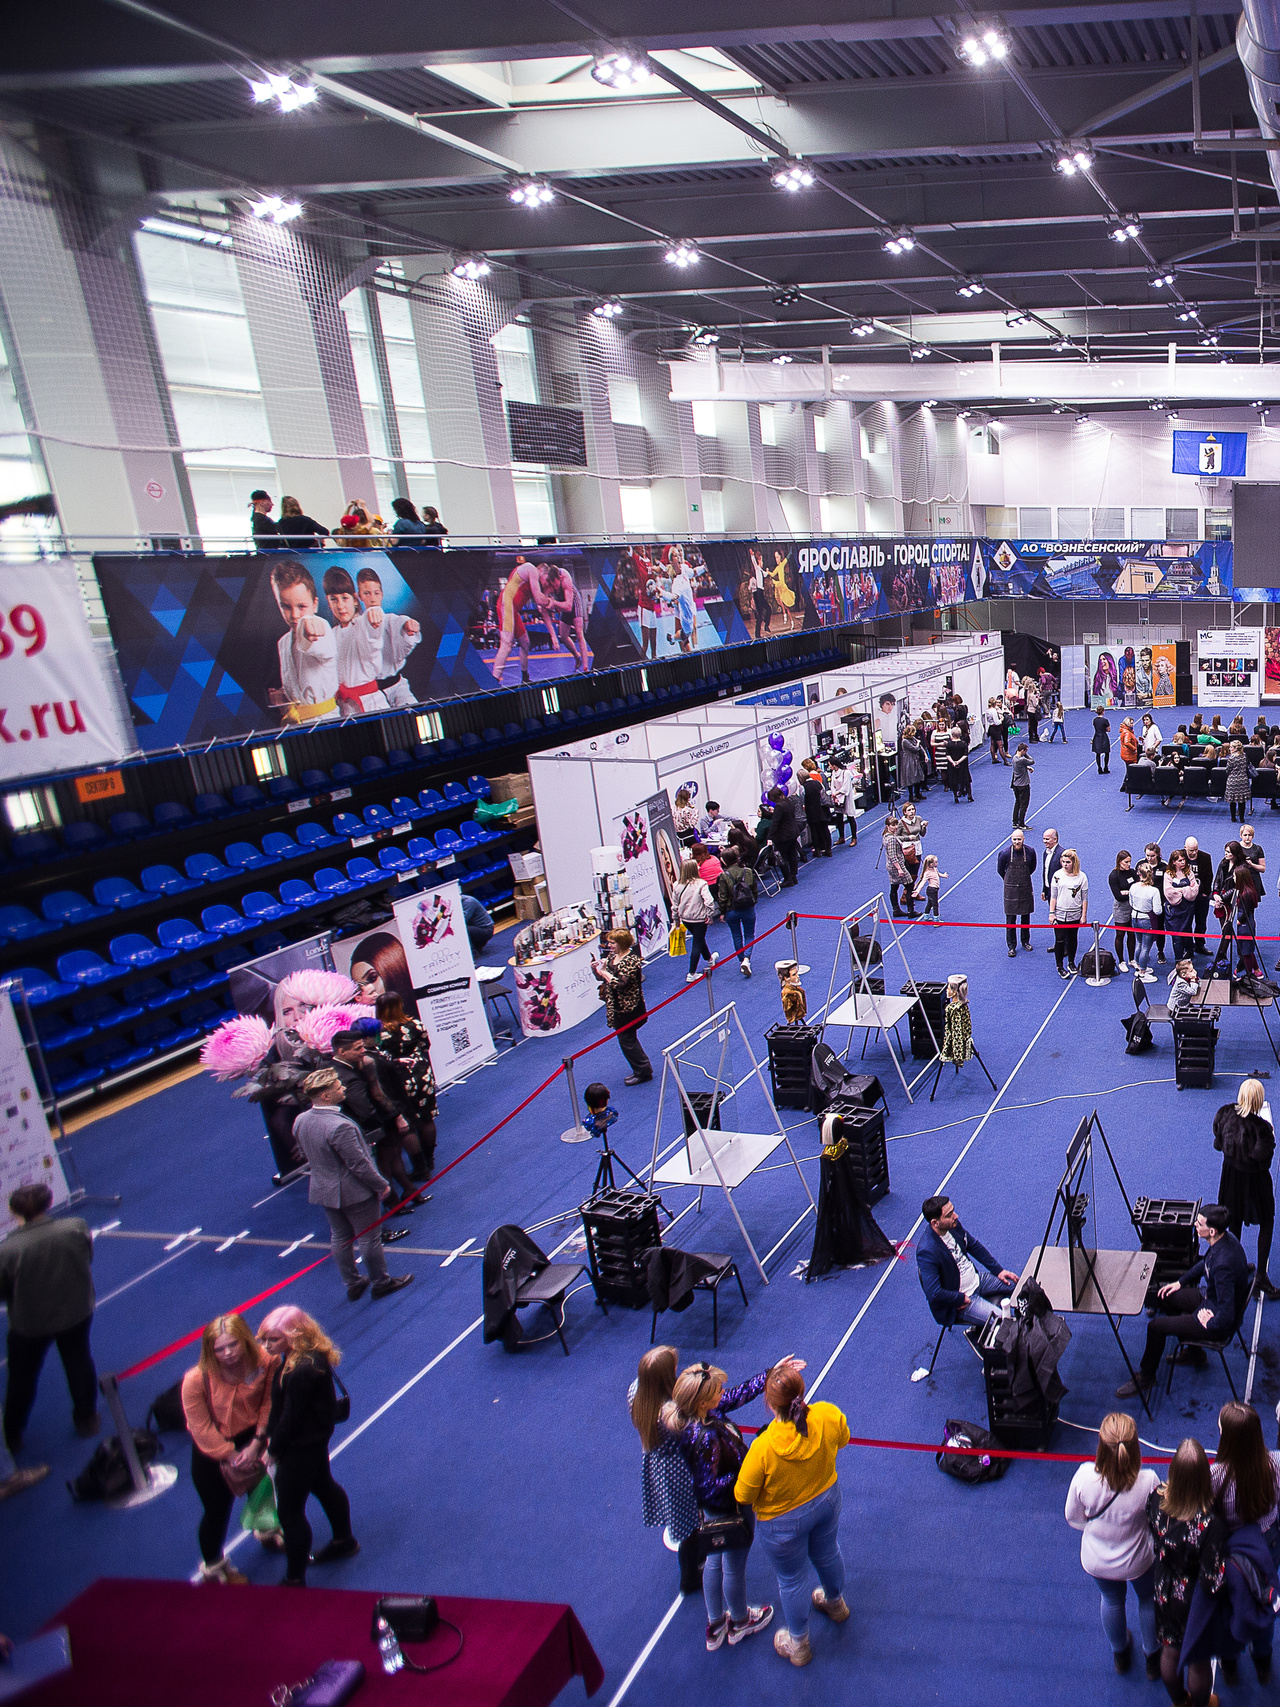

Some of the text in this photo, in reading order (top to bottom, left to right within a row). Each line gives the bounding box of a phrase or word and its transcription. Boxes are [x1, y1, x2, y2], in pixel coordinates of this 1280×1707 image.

[1020, 541, 1146, 553] АО “ВОЗНЕСЕНСКИЙ”
[798, 545, 885, 574] ЯРОСЛАВЛЬ
[893, 544, 931, 568] ГОРОД
[931, 543, 971, 563] СПОРТА!
[764, 719, 787, 733] Империя
[689, 741, 730, 761] Учебный центр
[422, 950, 462, 971] TRINITY
[564, 972, 592, 993] TRINIT
